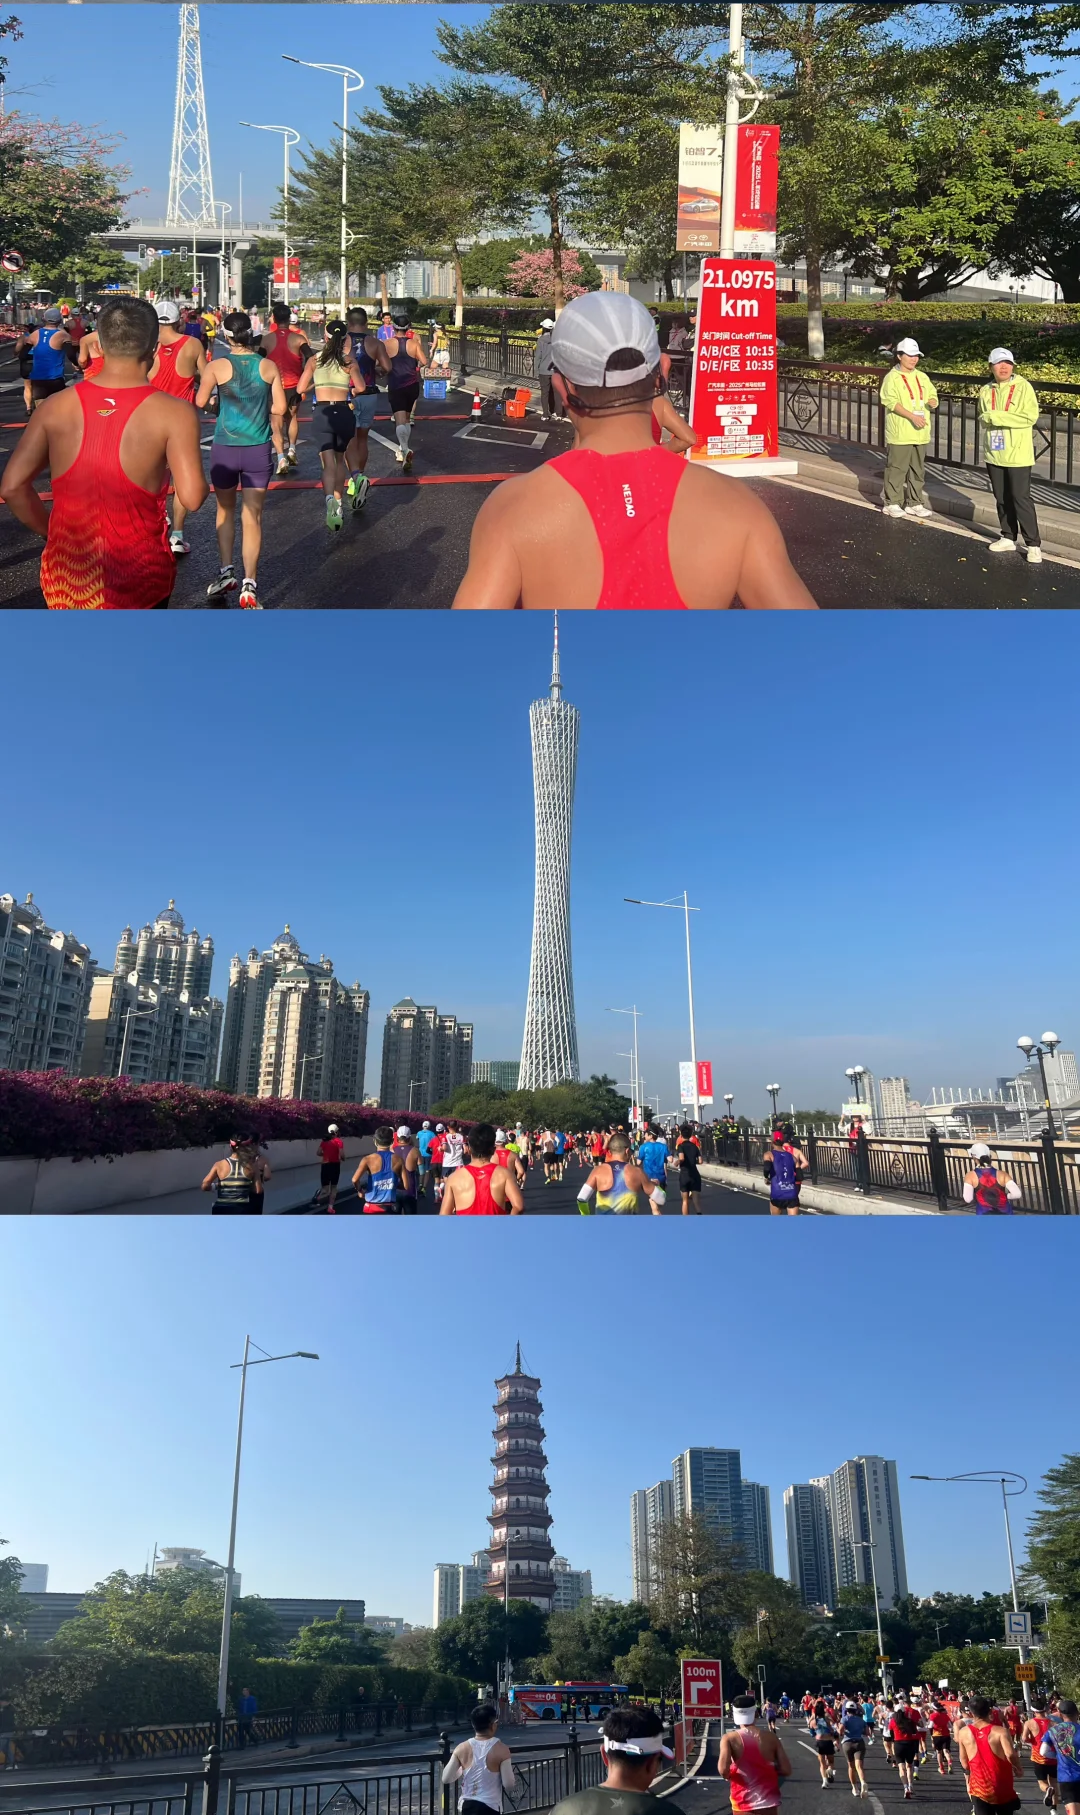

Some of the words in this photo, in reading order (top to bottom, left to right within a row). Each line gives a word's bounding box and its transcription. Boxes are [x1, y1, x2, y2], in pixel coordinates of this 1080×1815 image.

[703, 269, 774, 289] 21.0975
[721, 293, 759, 317] km
[702, 331, 730, 340] 关门时间
[756, 332, 773, 340] Time
[700, 345, 741, 358] A/B/C区
[745, 346, 774, 357] 10:15
[699, 359, 741, 373] D/E/F区
[745, 360, 774, 371] 10:35
[622, 484, 636, 518] NEDAO
[686, 1667, 716, 1677] 100m
[545, 1693, 557, 1701] 04
